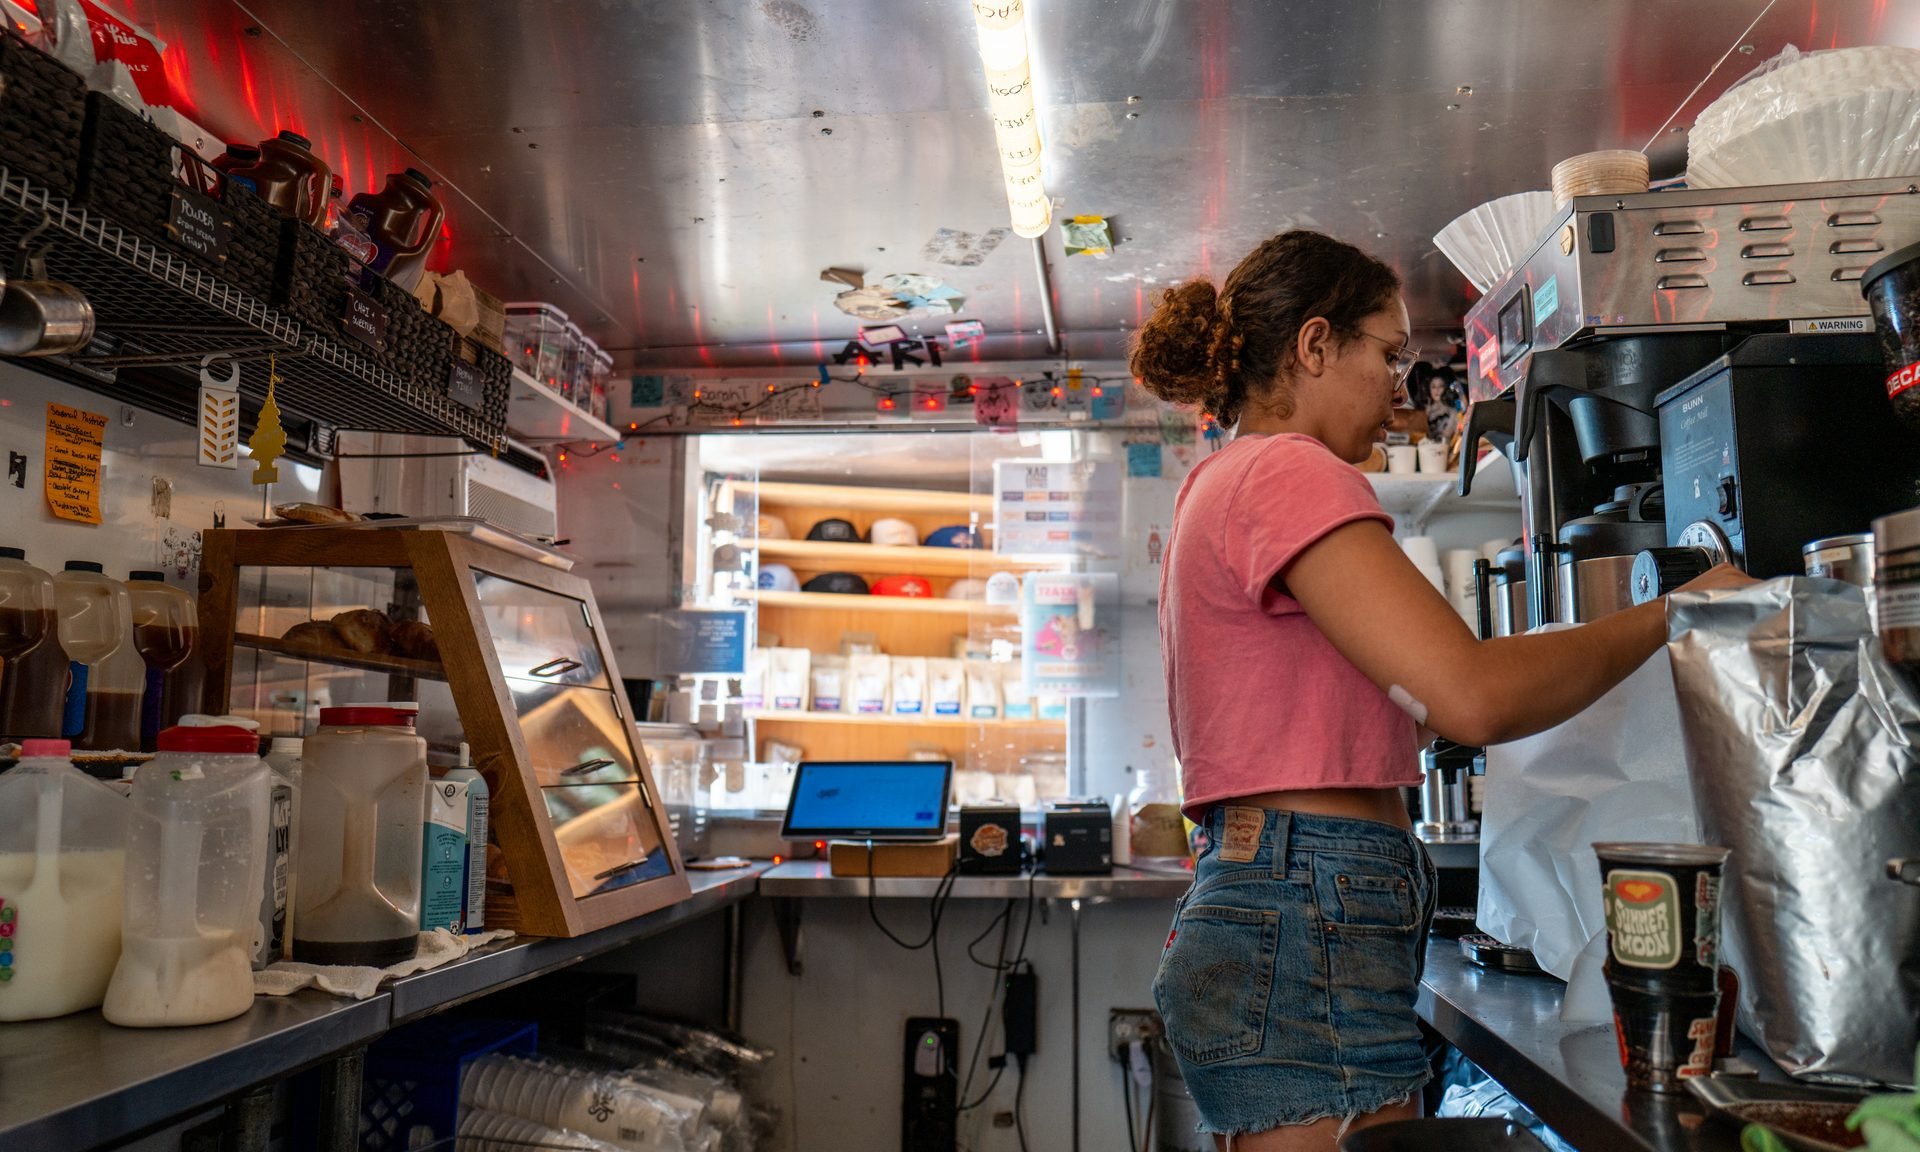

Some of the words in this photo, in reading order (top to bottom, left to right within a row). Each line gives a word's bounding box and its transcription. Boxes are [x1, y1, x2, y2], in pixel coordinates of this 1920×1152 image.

[181, 199, 214, 231] POWDER
[1819, 320, 1863, 329] WARNING
[1682, 394, 1704, 413] BUNN
[1680, 414, 1696, 431] Coffee
[1697, 406, 1709, 421] Mill
[1614, 898, 1669, 935] SUMMER
[1617, 930, 1671, 957] MOON
